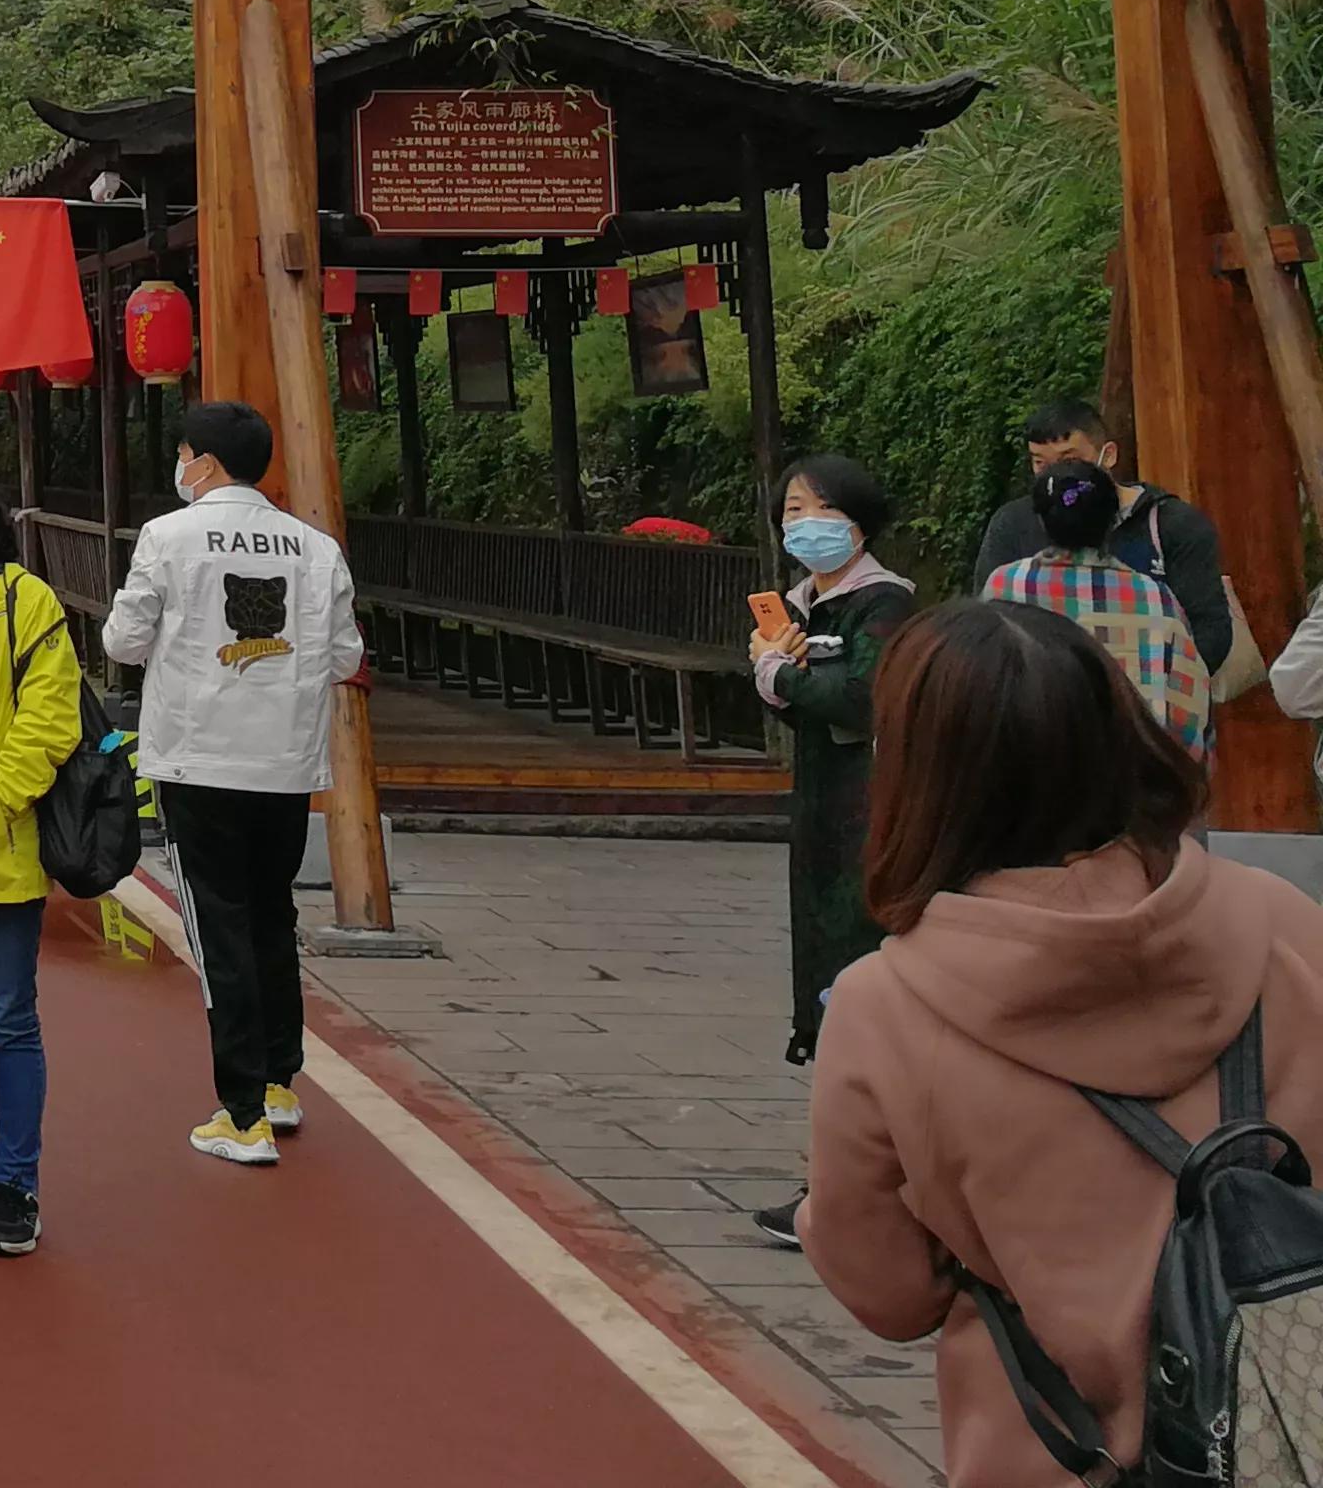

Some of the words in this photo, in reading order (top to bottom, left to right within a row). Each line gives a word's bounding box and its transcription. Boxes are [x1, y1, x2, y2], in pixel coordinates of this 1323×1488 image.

[410, 100, 558, 120] 土家风雨廊桥
[411, 120, 436, 132] The
[438, 120, 471, 133] Tujia
[472, 120, 517, 132] coverd
[206, 530, 303, 557] RABIN
